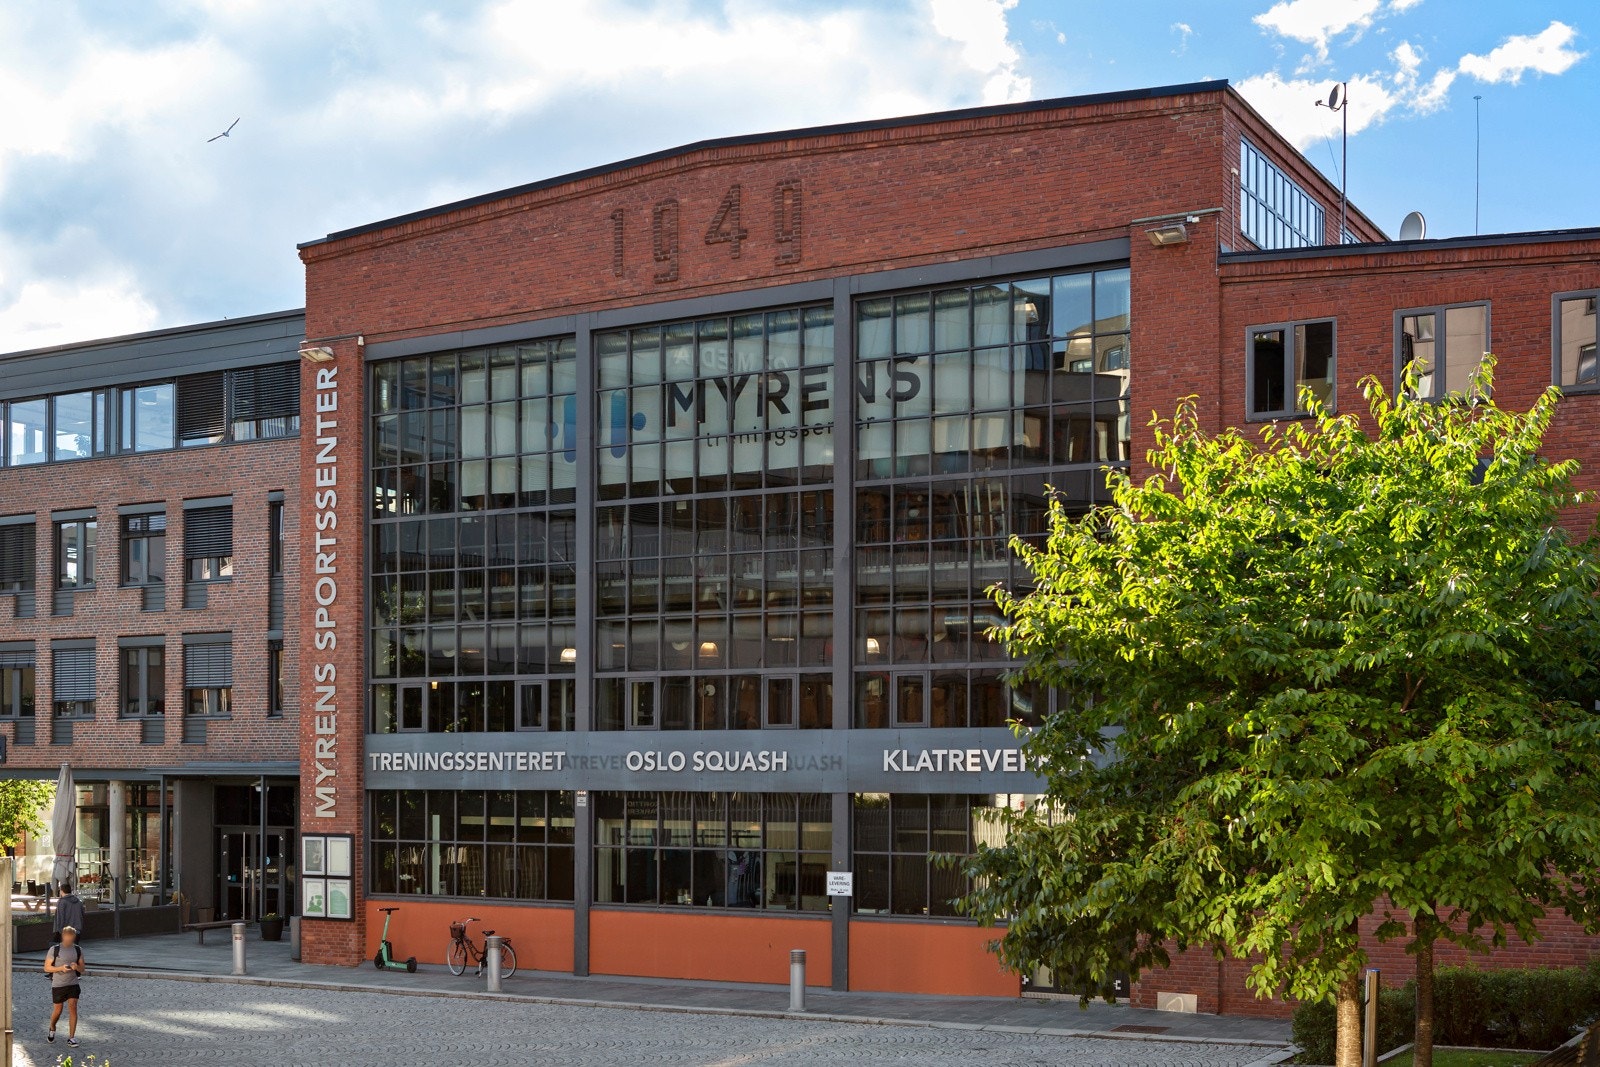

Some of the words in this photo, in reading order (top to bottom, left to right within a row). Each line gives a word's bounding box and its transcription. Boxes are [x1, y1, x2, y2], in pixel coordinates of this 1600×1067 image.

[610, 178, 802, 284] 1949
[666, 352, 921, 428] MYRENS
[314, 365, 339, 651] SPORTSSENTER
[314, 662, 338, 818] MYRENS
[369, 751, 567, 772] TRENINGSSENTERET
[625, 750, 686, 772] OSLO
[692, 750, 789, 772] SQUASH
